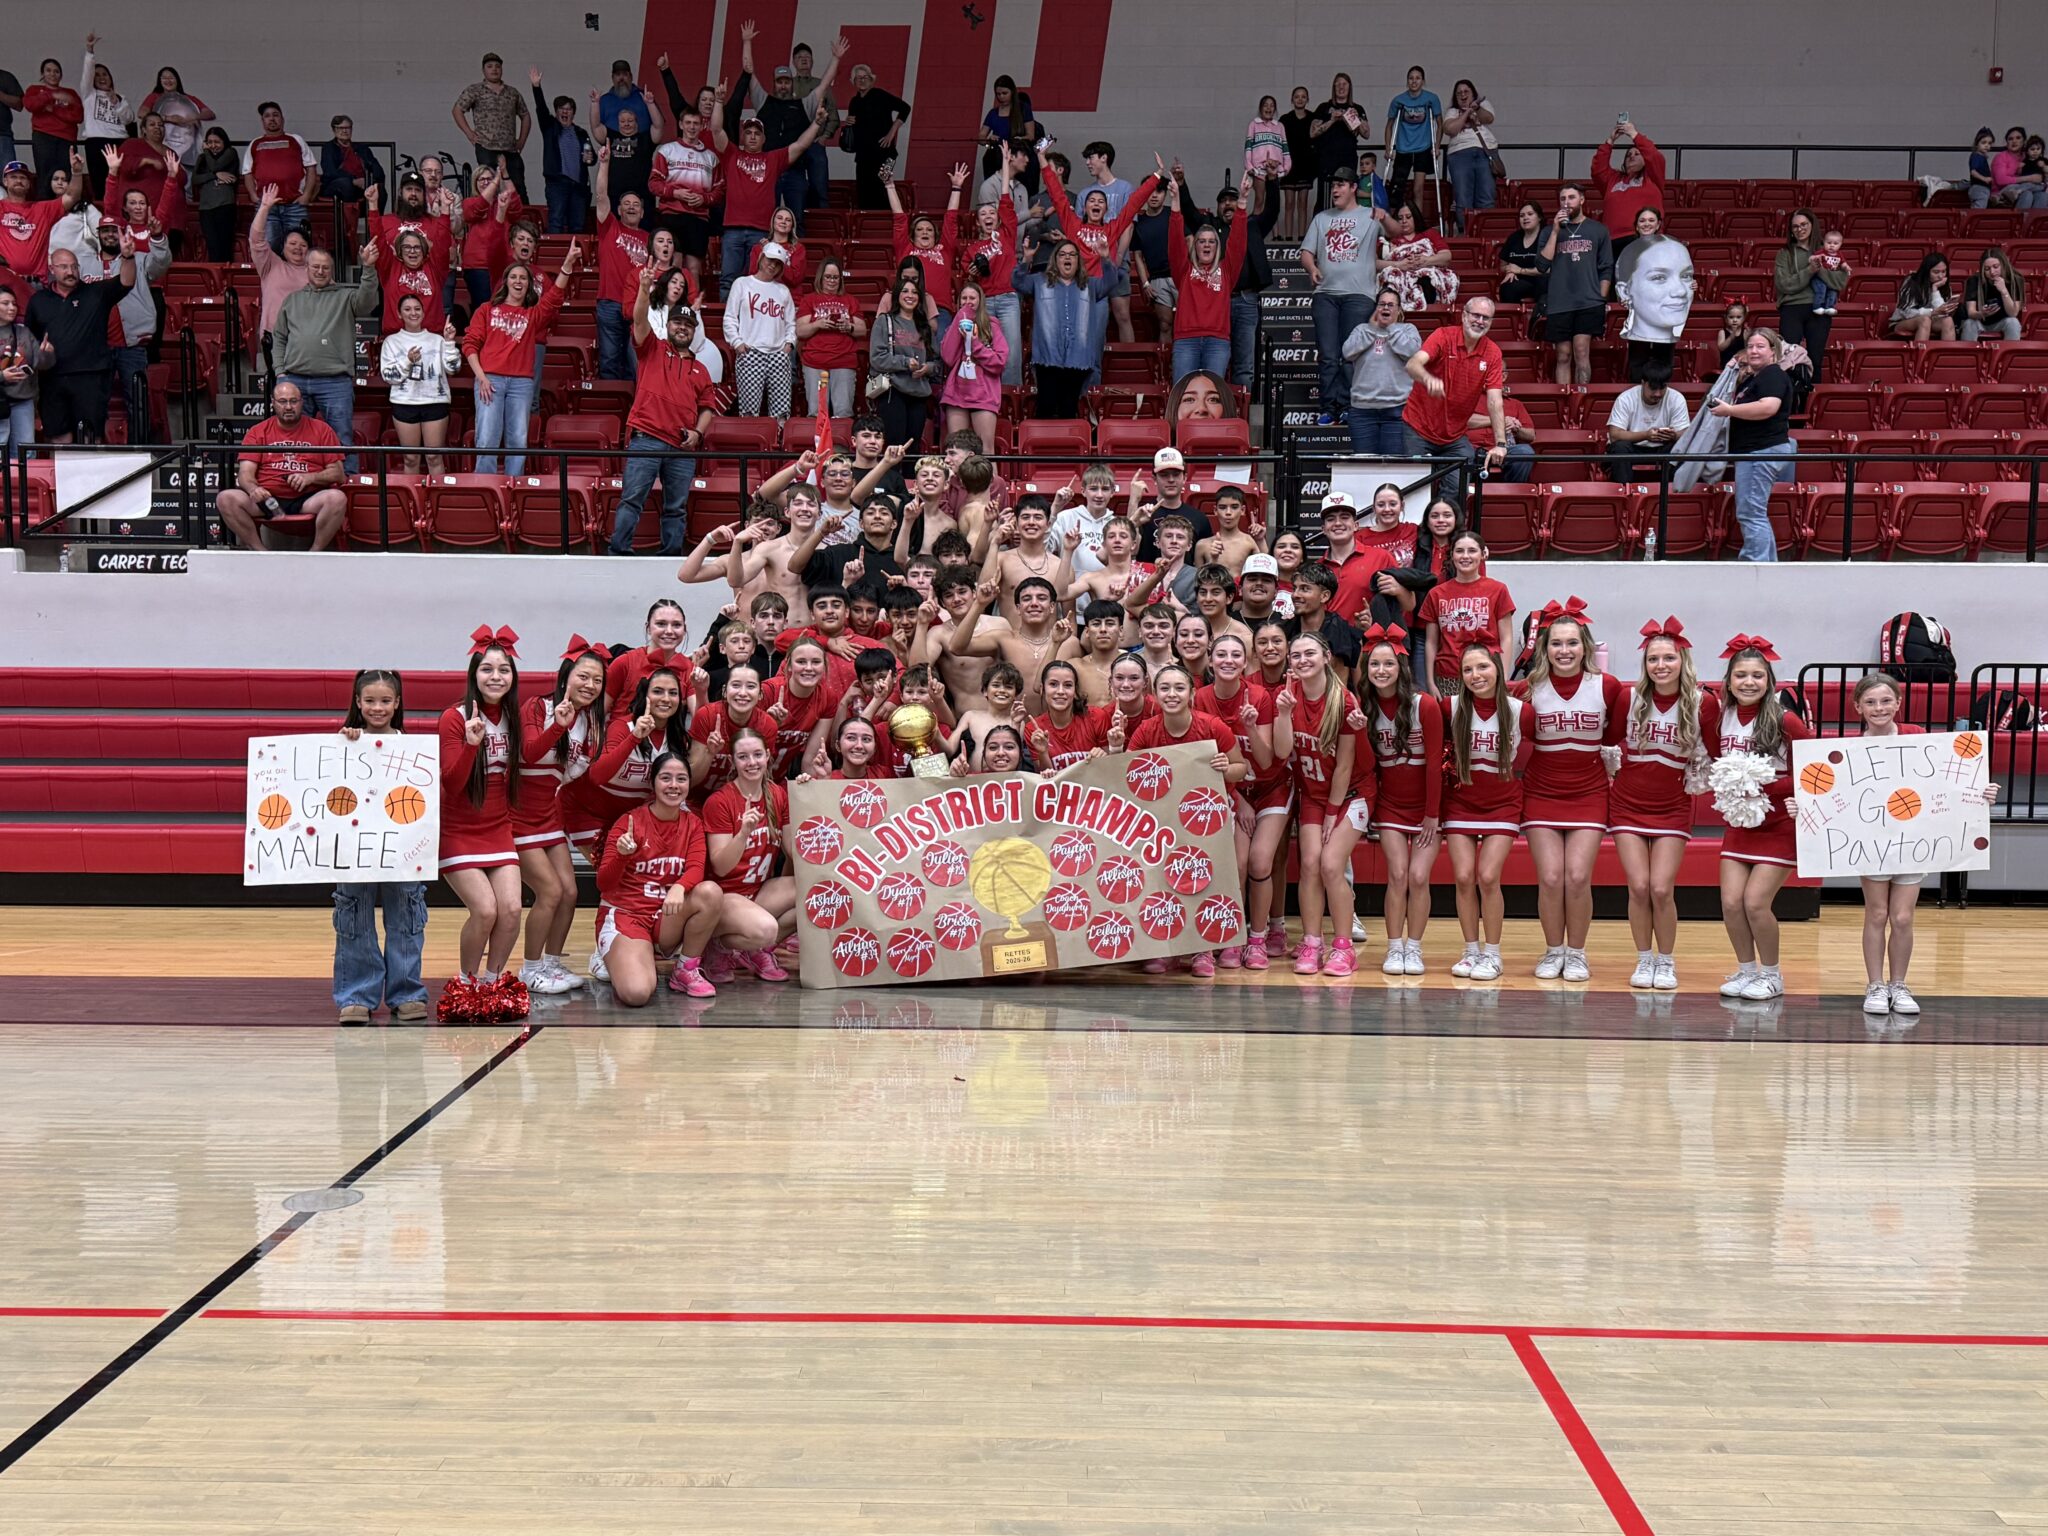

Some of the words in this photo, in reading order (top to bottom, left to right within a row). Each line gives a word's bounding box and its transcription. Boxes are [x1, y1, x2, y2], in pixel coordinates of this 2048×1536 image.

[98, 555, 157, 570] CARPET
[1439, 597, 1489, 616] RAIDER
[1528, 618, 1540, 650] PHS
[1895, 624, 1906, 656] PHS
[1882, 631, 1892, 663] PHS
[1537, 711, 1600, 733] PHS
[294, 744, 374, 781] LETS
[381, 750, 437, 786] #5
[1300, 756, 1326, 782] 21
[1845, 744, 1938, 786] LETS
[1938, 754, 1985, 791] #1
[1799, 799, 1833, 836] #1
[834, 778, 1024, 895] BI-DISTRICT
[1033, 780, 1177, 867] CHAMPS
[1826, 821, 1967, 871] Payton!
[257, 831, 400, 874] MALLEE
[925, 851, 965, 867] Juliet
[1053, 843, 1093, 858] Payton
[1075, 853, 1087, 864] #1
[742, 853, 773, 883] 24
[1169, 857, 1208, 876] Alexa
[1100, 867, 1141, 886] Allison
[1126, 877, 1140, 888] #3
[808, 893, 852, 910] Ashlyn
[1054, 893, 1080, 904] Coach
[818, 906, 836, 918] #20
[936, 912, 978, 929] Brissa
[1200, 905, 1236, 924] Maci
[949, 926, 967, 938] #15
[1004, 948, 1031, 957] RETTES
[1006, 956, 1031, 965] 2025-26
